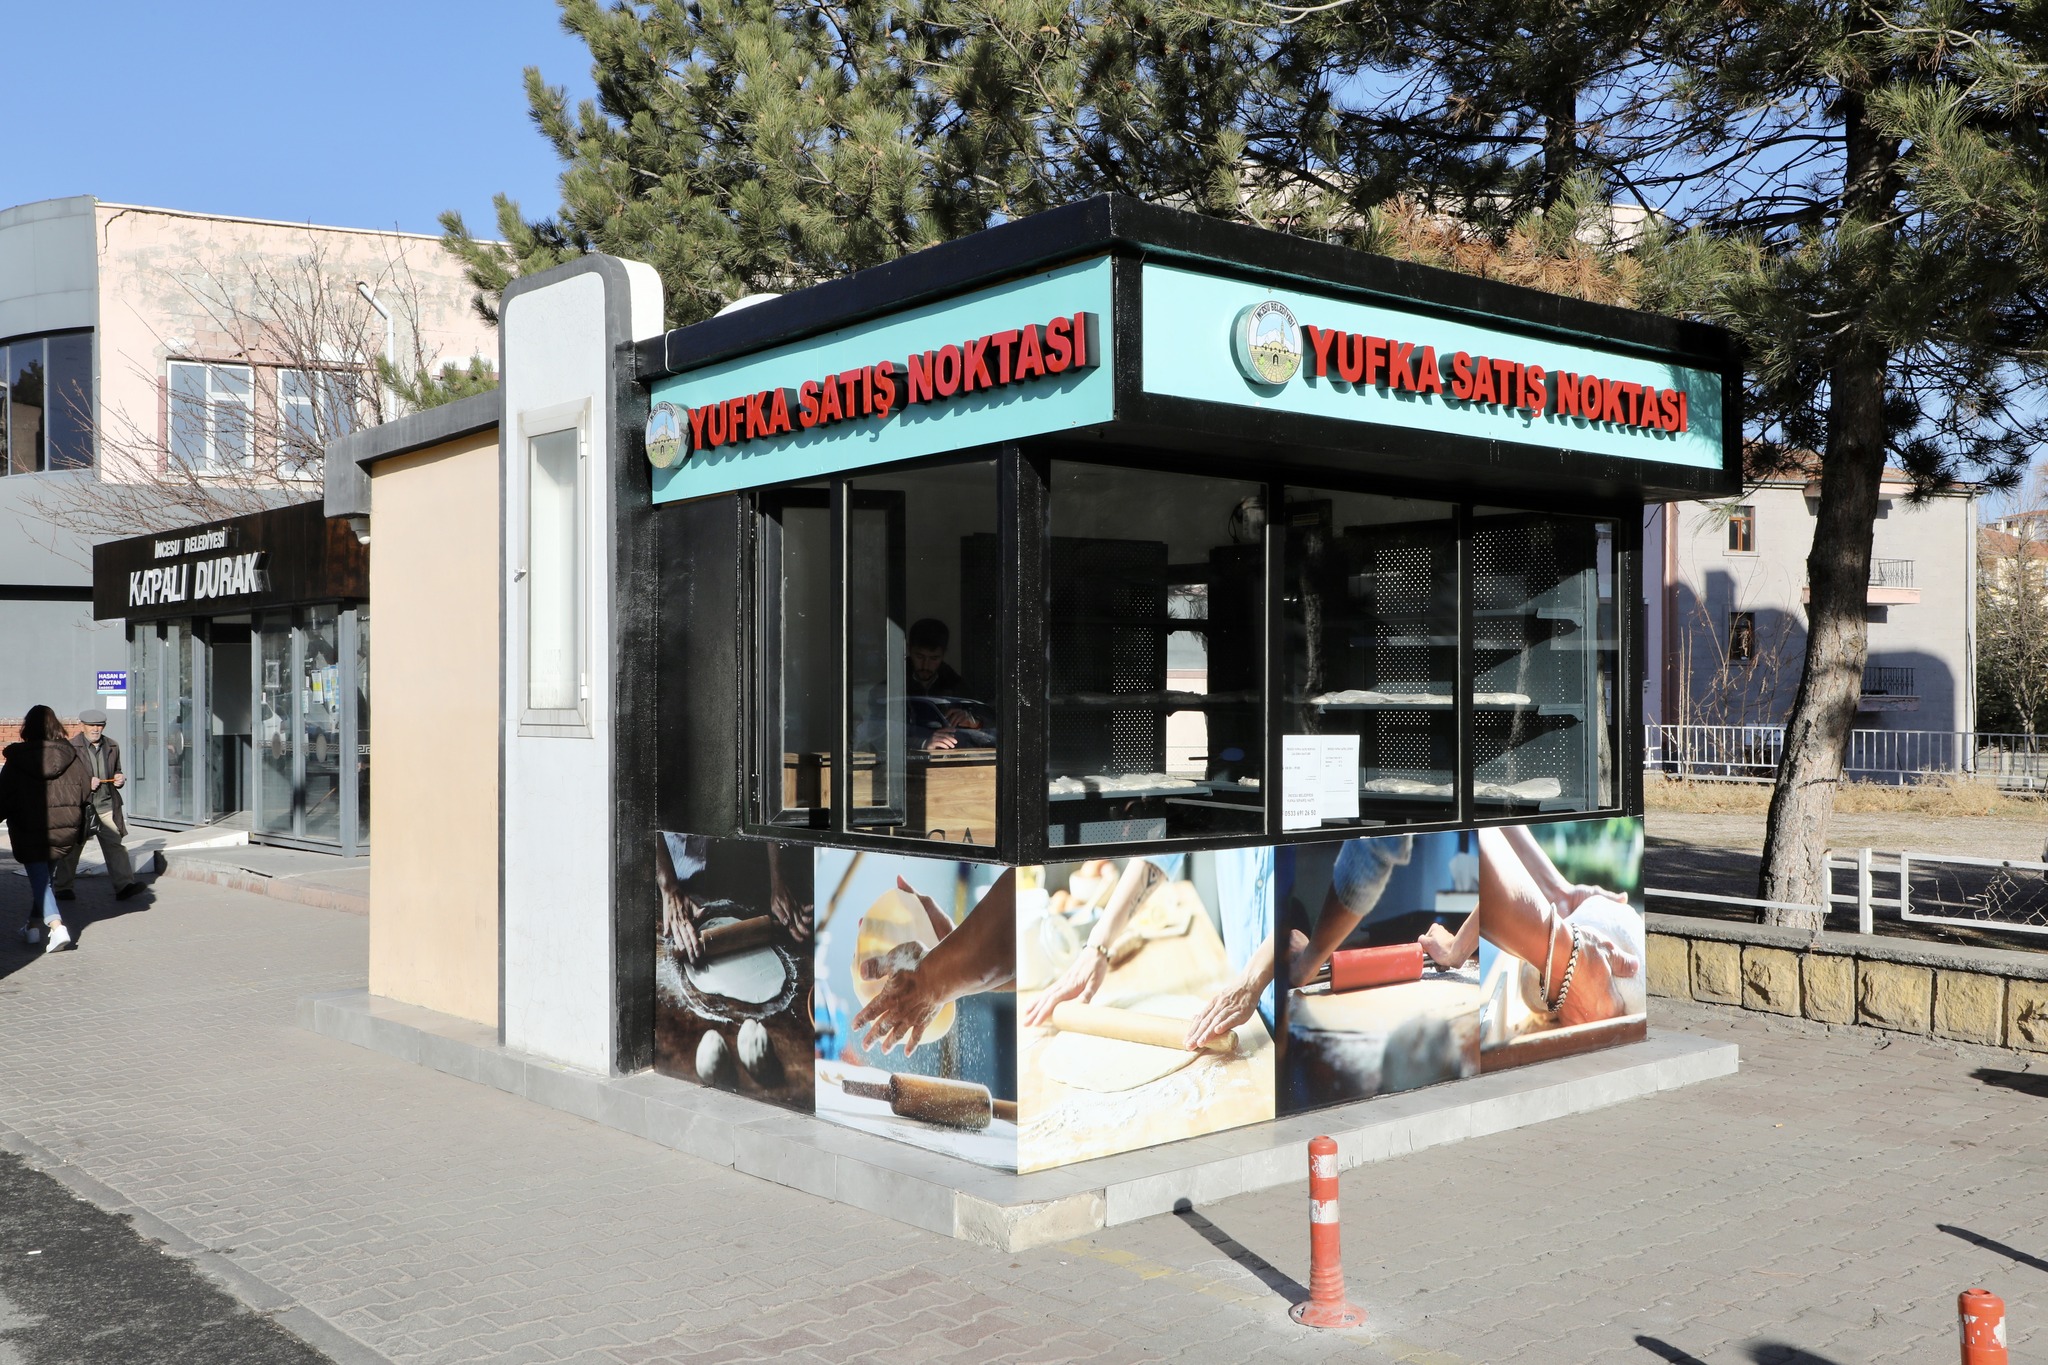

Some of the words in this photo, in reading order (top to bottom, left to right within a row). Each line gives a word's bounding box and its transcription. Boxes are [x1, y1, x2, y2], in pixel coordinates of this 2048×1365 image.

[687, 386, 792, 450] YUFKA
[799, 360, 896, 428] SATIŞ
[908, 312, 1087, 404] NOKTASI
[1304, 325, 1443, 395] YUFKA
[1451, 351, 1548, 419] SATIŞ
[1557, 370, 1689, 433] NOKTASI
[129, 563, 188, 607] KAPALI
[194, 552, 258, 599] DURAK
[154, 540, 180, 559] İNCESU
[184, 527, 225, 554] BELEDİYESİ
